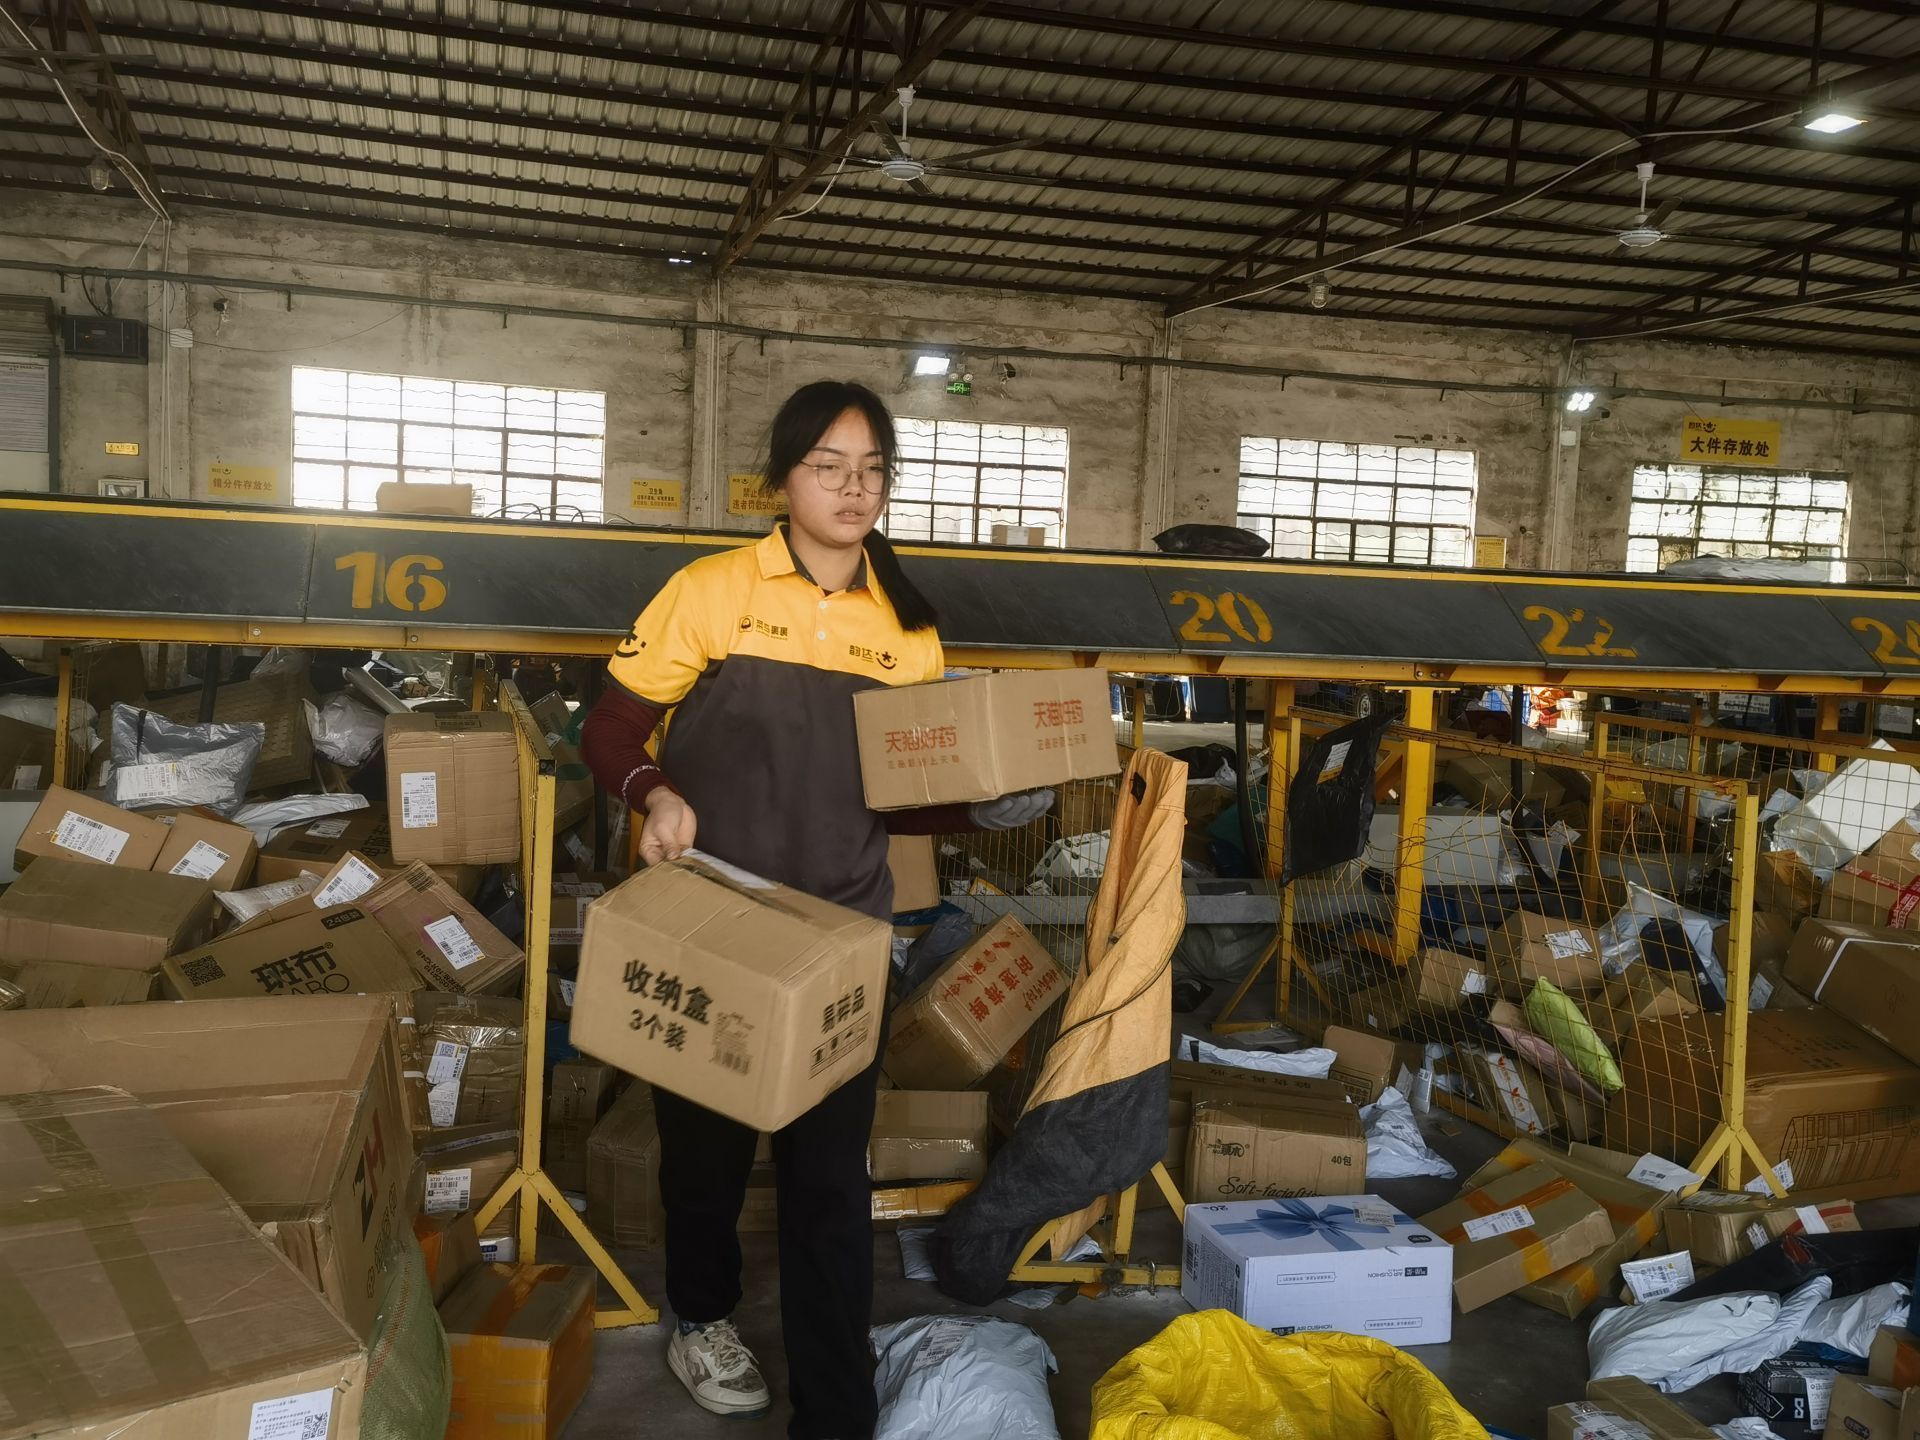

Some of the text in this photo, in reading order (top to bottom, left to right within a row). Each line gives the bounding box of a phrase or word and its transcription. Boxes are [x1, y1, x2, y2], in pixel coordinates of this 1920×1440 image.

[1690, 436, 1769, 457] 大件存放处
[733, 499, 784, 511] 违者罚款500元
[335, 552, 446, 611] 16
[756, 619, 788, 637] 菜鸟裹裹
[1169, 590, 1272, 643] 20
[1523, 605, 1638, 657] 22
[849, 645, 873, 660] 韵达
[1034, 700, 1084, 728] 天猫好药
[885, 725, 957, 753] 天猫好药
[250, 945, 337, 992] 斑布
[623, 959, 713, 1026] 收纳盒
[629, 1009, 687, 1053] 3个装
[1331, 1155, 1352, 1166] 40包
